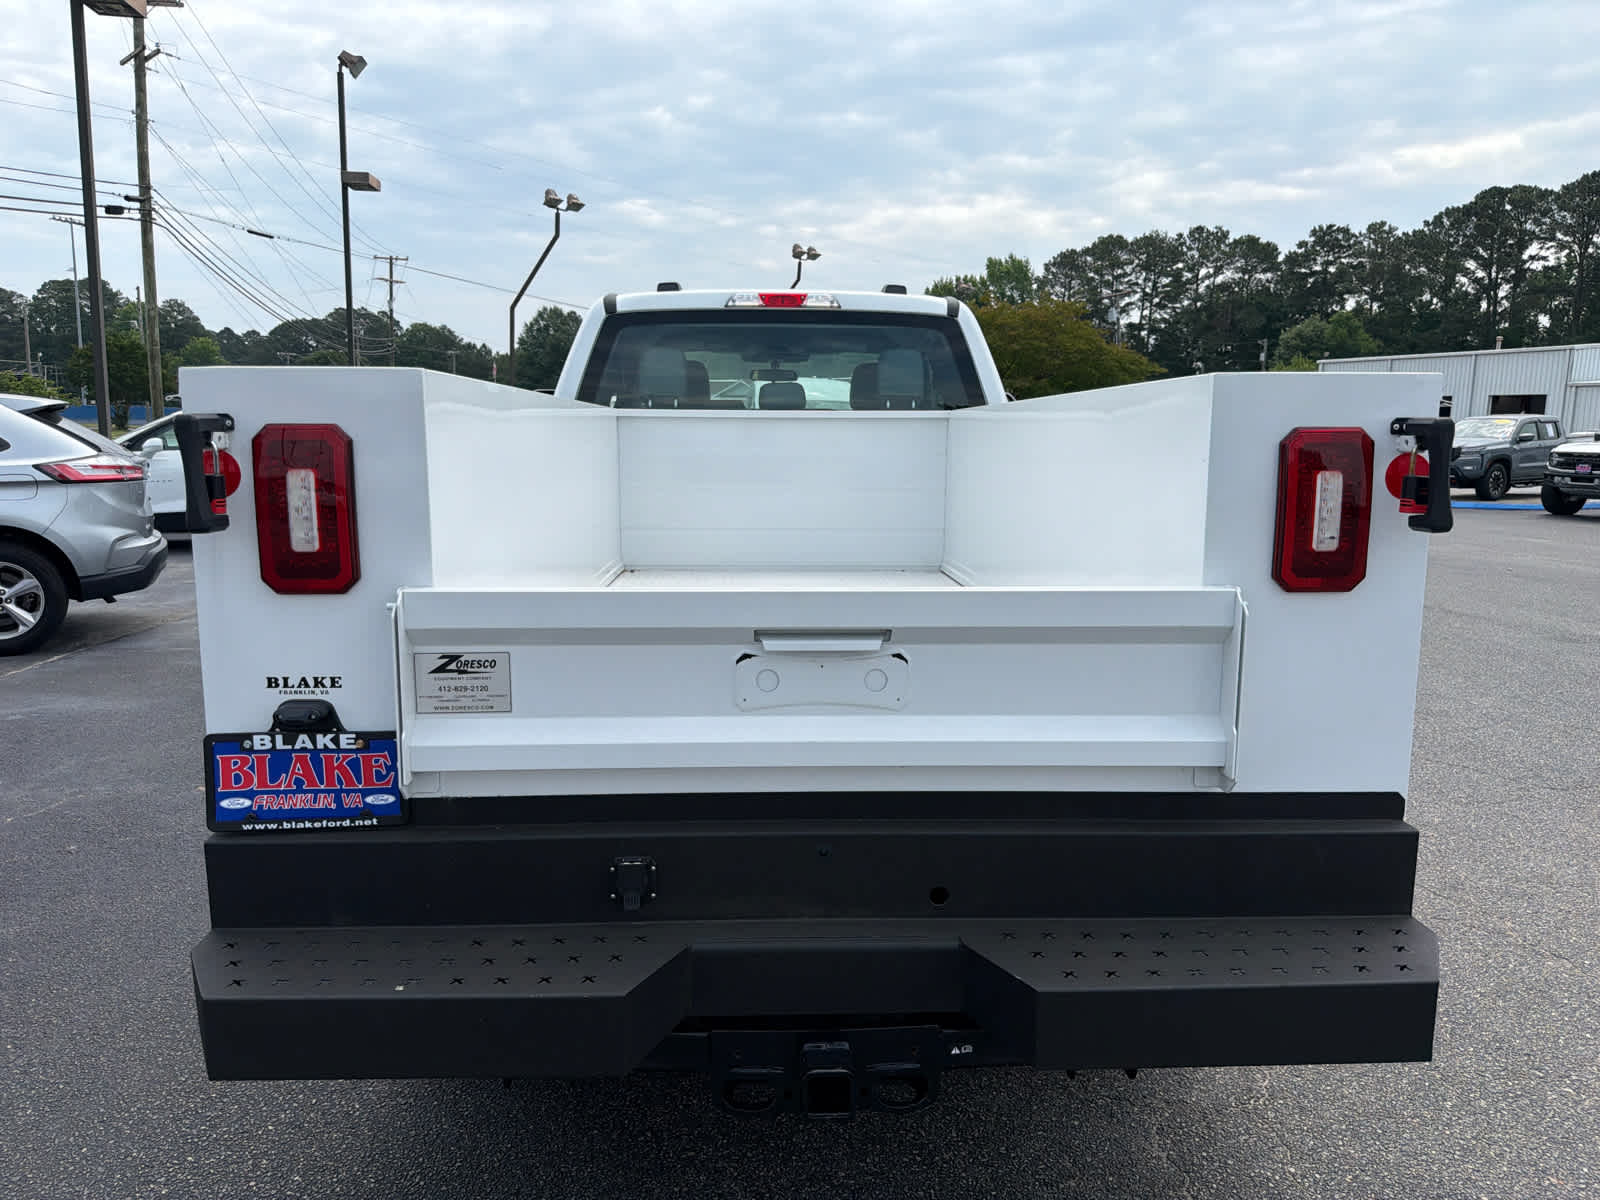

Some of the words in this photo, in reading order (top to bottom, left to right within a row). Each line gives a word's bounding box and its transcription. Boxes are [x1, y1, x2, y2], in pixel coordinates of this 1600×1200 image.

[428, 654, 497, 675] ZORESCO
[265, 676, 343, 689] BLAKE
[252, 733, 356, 750] BLAKE
[216, 751, 395, 792] BLAKE
[252, 793, 336, 810] FRANKLIN,
[341, 793, 364, 808] VA
[241, 818, 378, 830] www.blakeford.net
